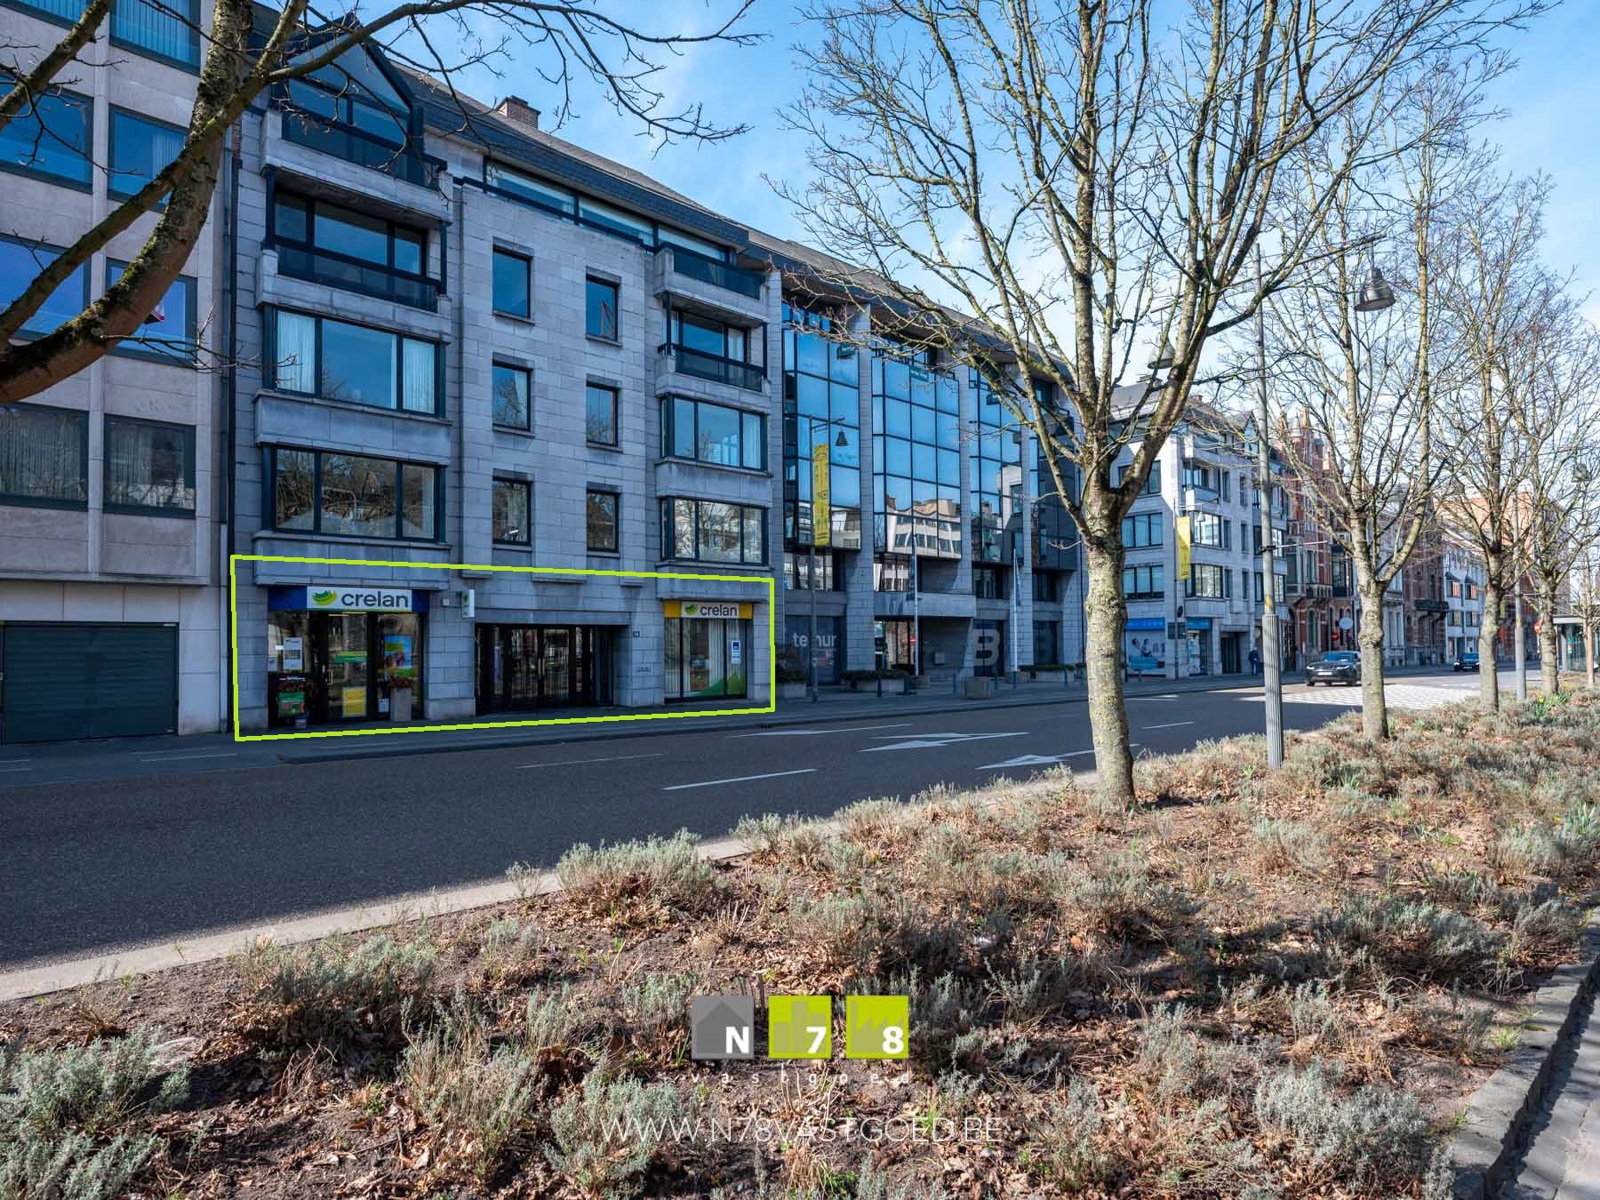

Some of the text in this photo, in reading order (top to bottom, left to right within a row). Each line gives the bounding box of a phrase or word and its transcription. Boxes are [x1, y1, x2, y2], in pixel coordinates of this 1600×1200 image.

[341, 591, 408, 608] crelan
[700, 603, 738, 616] crelan
[792, 632, 808, 648] te
